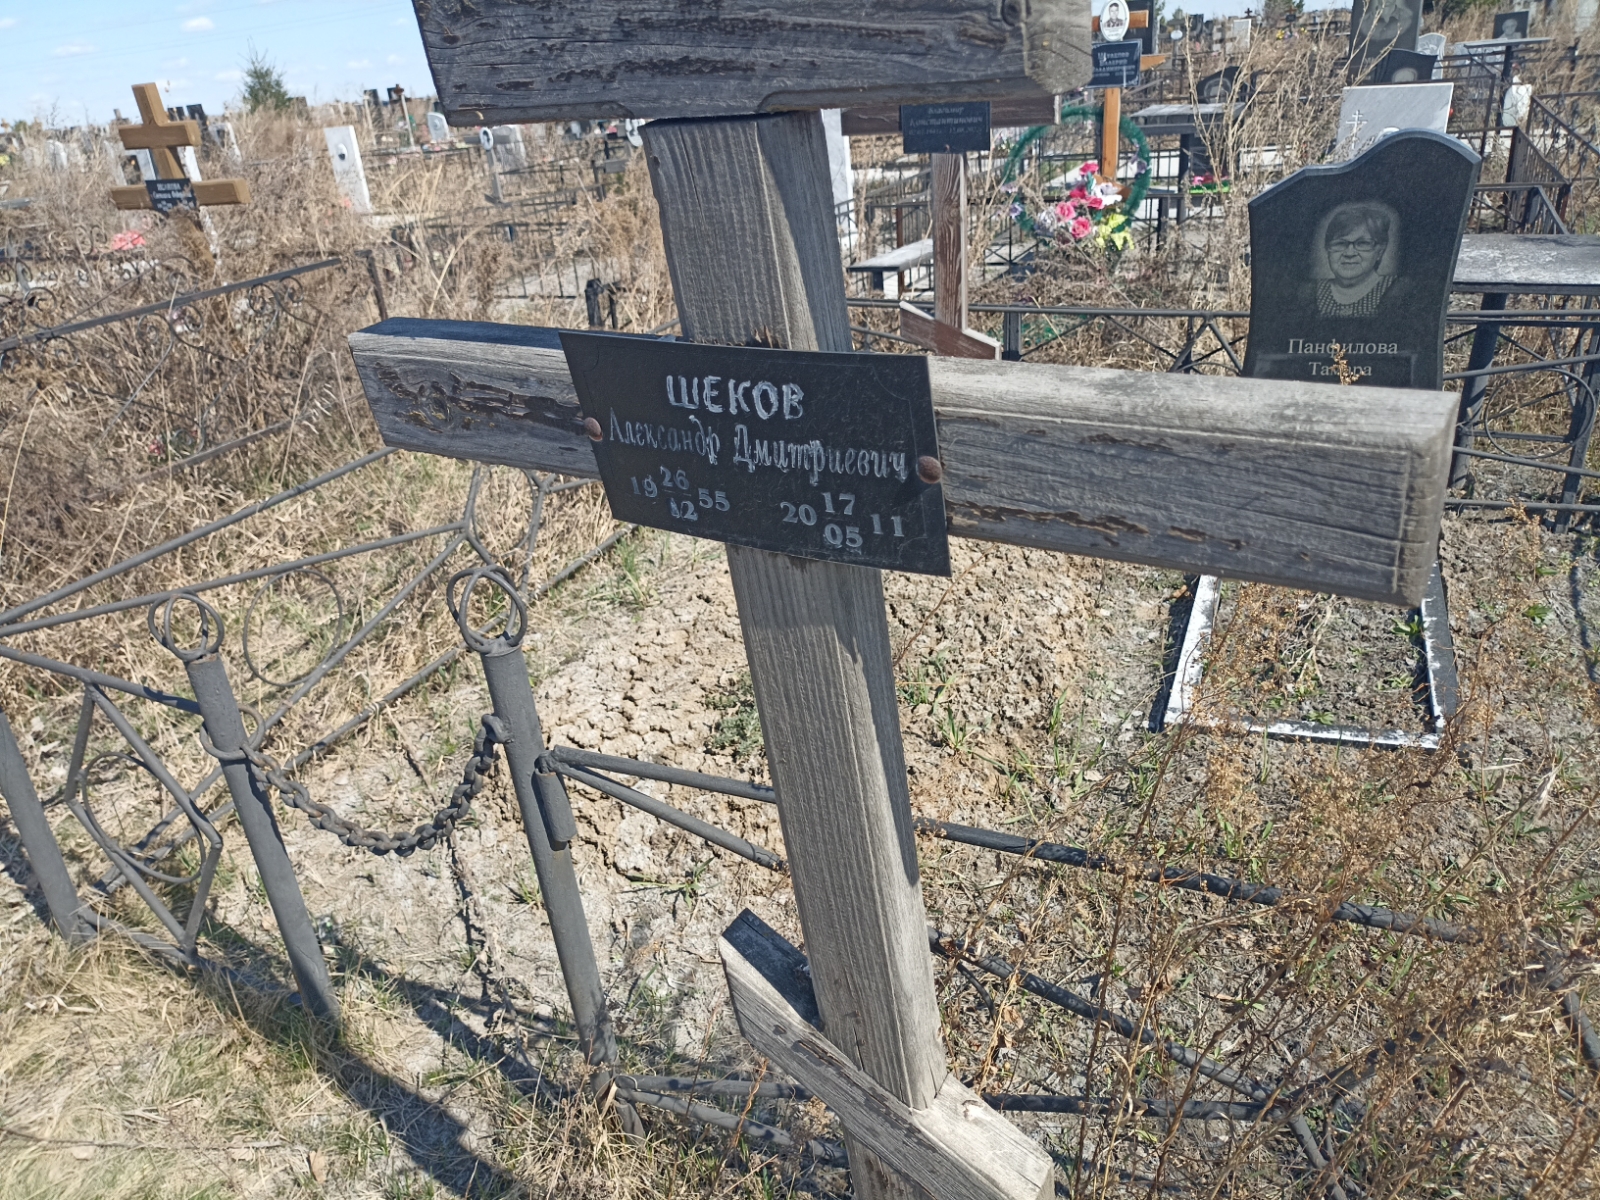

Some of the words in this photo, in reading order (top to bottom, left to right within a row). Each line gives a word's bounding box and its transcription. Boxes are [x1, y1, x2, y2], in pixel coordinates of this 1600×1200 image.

[1287, 338, 1399, 359] Панфилова
[666, 375, 804, 421] ШЕКОВ
[609, 406, 721, 465] Александр
[732, 424, 909, 487] Дмитриевич
[630, 474, 658, 498] 19
[660, 465, 690, 491] 26
[698, 487, 731, 512] 55
[780, 501, 818, 526] 20
[821, 491, 855, 516] 17
[823, 523, 864, 549] 05
[870, 513, 905, 537] 11
